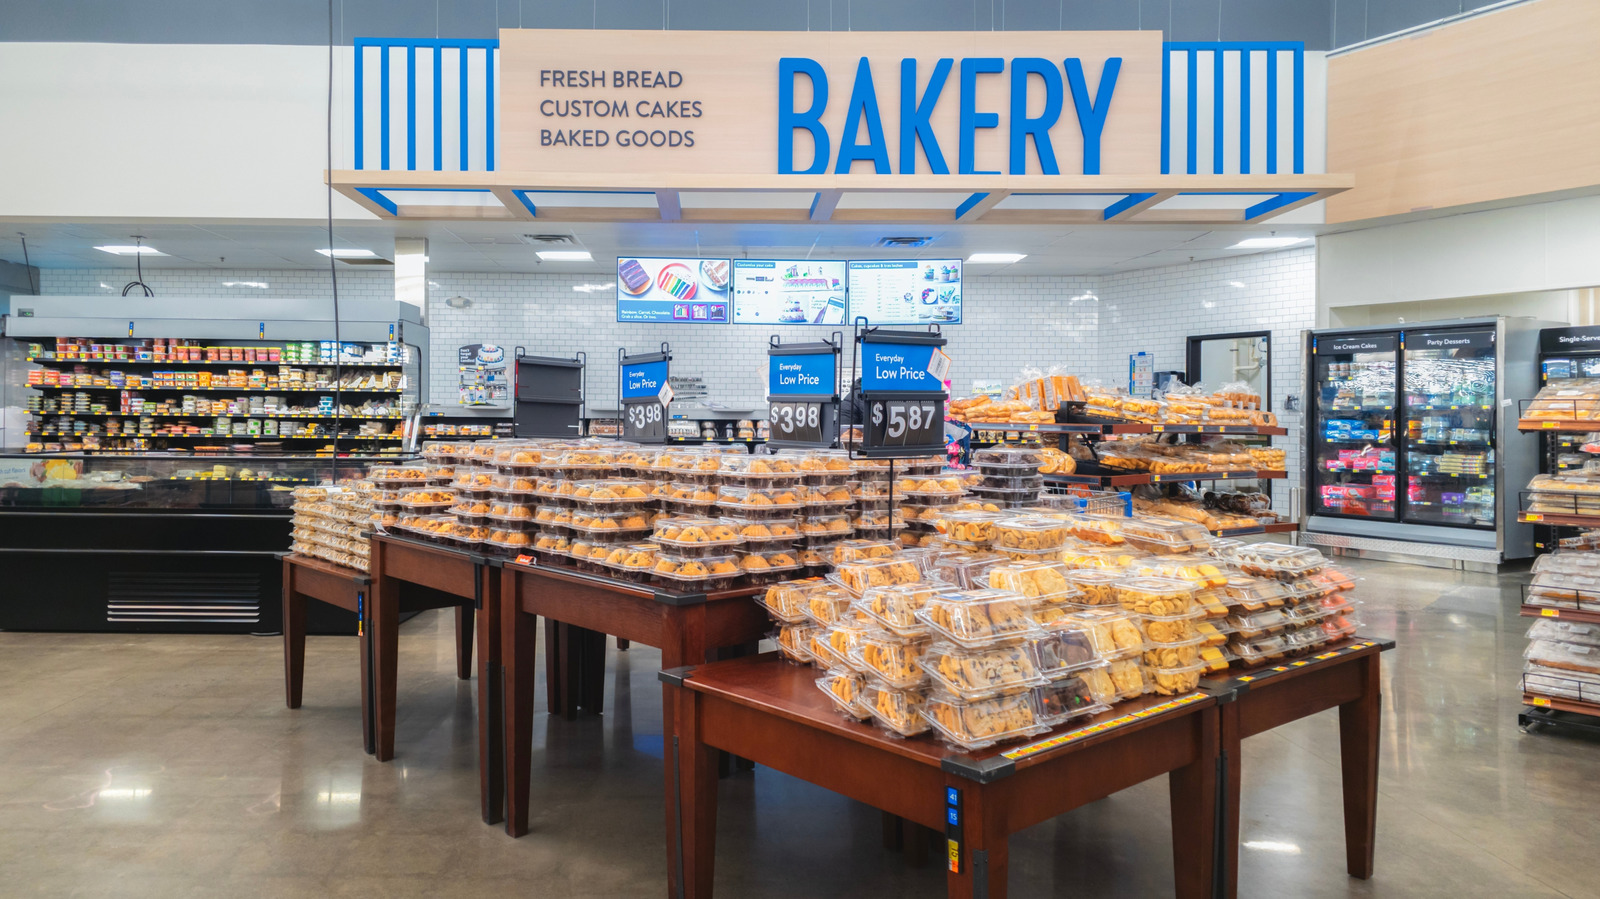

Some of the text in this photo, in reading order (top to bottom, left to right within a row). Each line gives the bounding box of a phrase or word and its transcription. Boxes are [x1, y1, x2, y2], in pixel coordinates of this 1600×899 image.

[540, 70, 683, 89] FRESH BREAD
[540, 99, 703, 118] CUSTOM CAKES
[777, 56, 1123, 176] BAKERY
[540, 129, 695, 148] BAKED GOODS
[779, 363, 802, 372] Everyday
[875, 353, 905, 364] Everyday
[629, 371, 645, 379] Everyday
[779, 373, 820, 385] Low Price
[876, 366, 925, 380] Low Price
[629, 379, 657, 390] Low Price
[628, 403, 662, 429] $398
[770, 406, 819, 434] $398
[872, 401, 936, 438] $587
